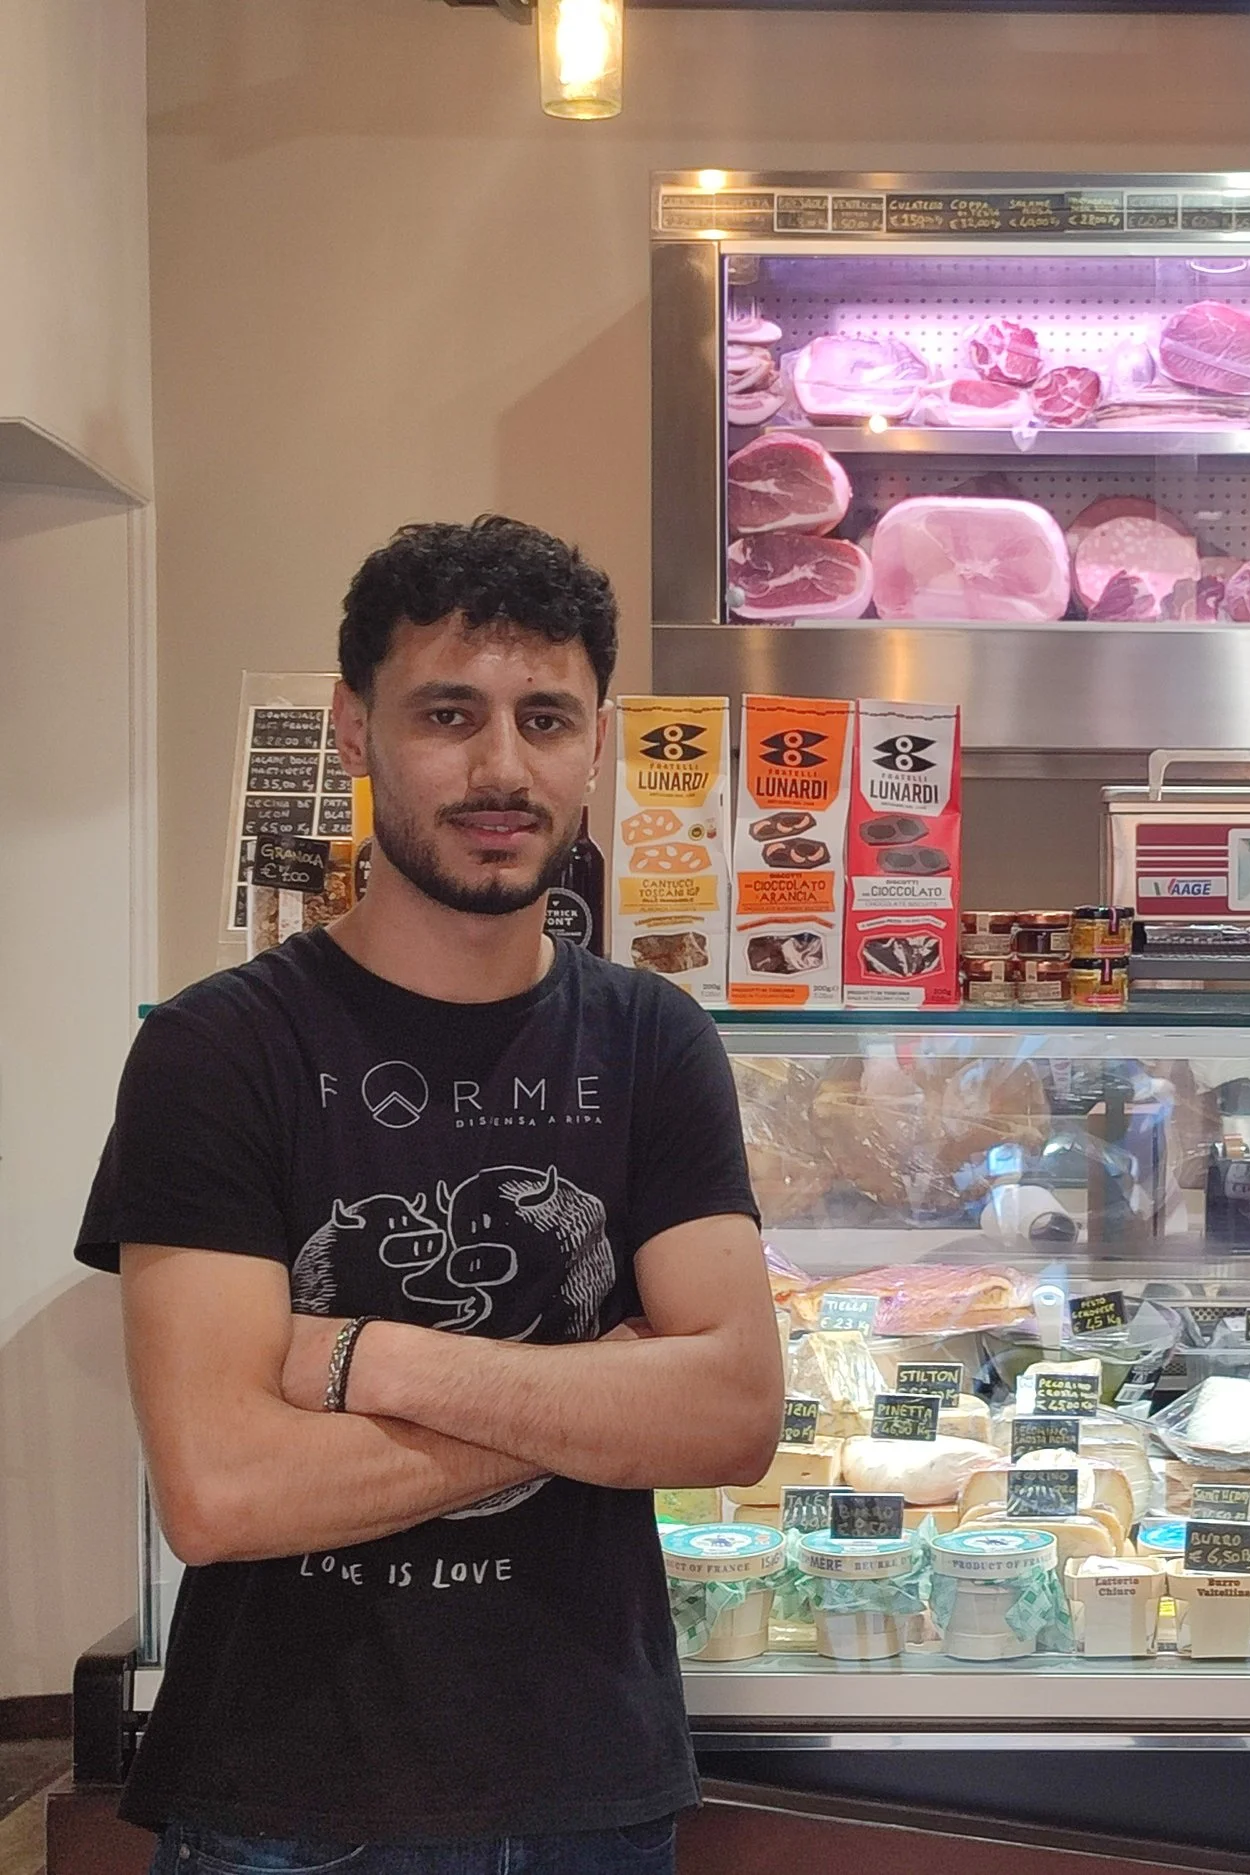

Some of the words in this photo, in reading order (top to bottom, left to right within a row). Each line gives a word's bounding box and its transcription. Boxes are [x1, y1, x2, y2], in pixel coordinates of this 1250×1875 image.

[638, 772, 709, 791] LUNARDI
[756, 776, 828, 801] LUNARDI
[870, 779, 939, 804] LUNARDI
[260, 843, 324, 869] GRANOLA
[642, 879, 695, 889] CANTUCCI
[754, 880, 826, 892] CIOCCOLATO
[871, 886, 942, 897] CIOCCOLATO
[547, 909, 578, 917] TRICK
[547, 917, 573, 926] ONT
[320, 1060, 600, 1128] FORME
[456, 1115, 536, 1128] DISENSA
[548, 1115, 556, 1124] A
[833, 1317, 853, 1330] 23
[899, 1369, 959, 1383] STILTON
[1039, 1378, 1092, 1391] PECORINO
[877, 1403, 932, 1419] PINETTA
[1191, 1531, 1242, 1546] BURRO
[706, 1562, 750, 1574] FRANCE
[952, 1559, 1002, 1570] PRODUCT
[1006, 1560, 1019, 1569] OF
[389, 1561, 413, 1588] IS
[432, 1558, 513, 1589] LOVE
[1207, 1577, 1241, 1587] Burro
[1196, 1587, 1250, 1598] Valtellina
